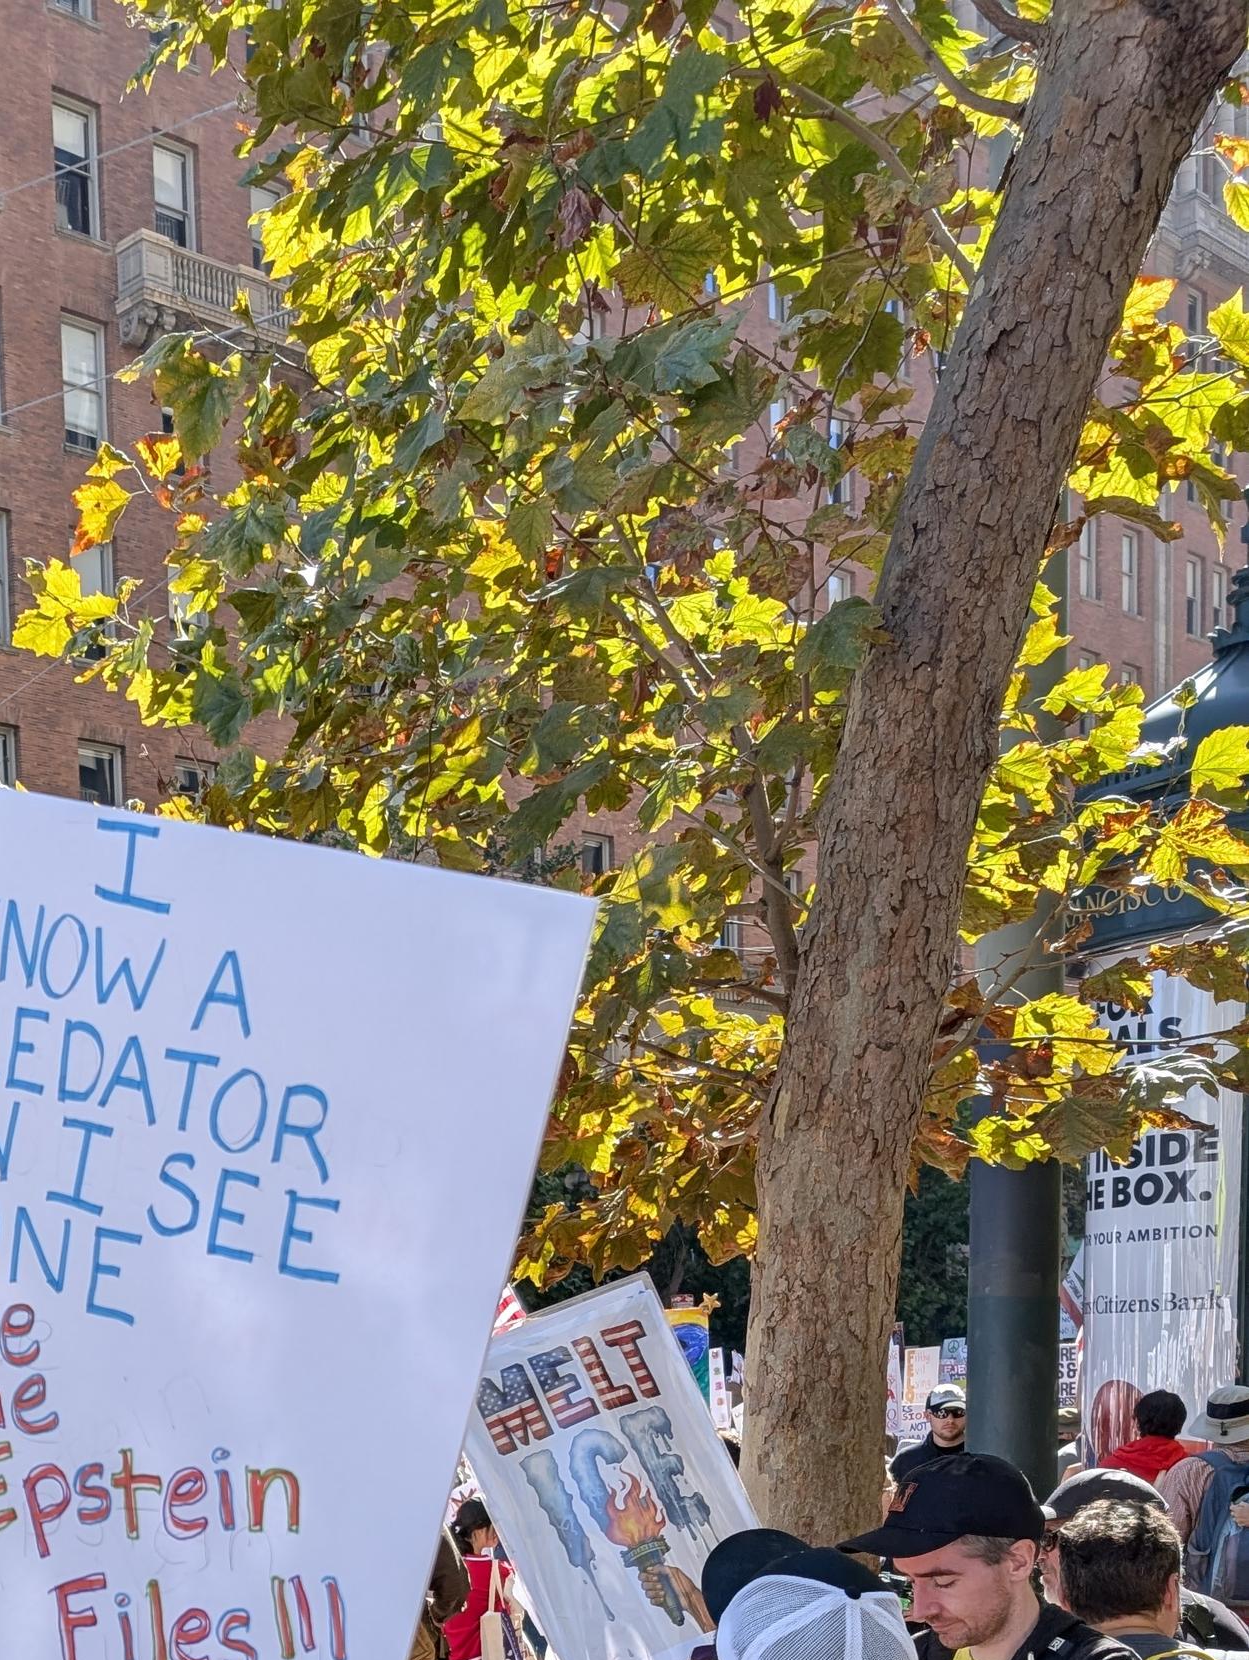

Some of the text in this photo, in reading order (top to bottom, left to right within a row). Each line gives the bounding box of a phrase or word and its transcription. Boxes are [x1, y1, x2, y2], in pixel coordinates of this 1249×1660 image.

[93, 817, 171, 915] I
[190, 949, 253, 1039] A
[45, 1116, 114, 1217] I
[148, 1152, 342, 1286] SEE
[1086, 1169, 1213, 1211] HE BOX.
[1094, 1230, 1122, 1246] YOUR
[1126, 1224, 1220, 1243] AMBITION
[476, 1319, 661, 1456] MELT
[910, 1422, 928, 1432] NOT
[519, 1405, 712, 1590] ICE
